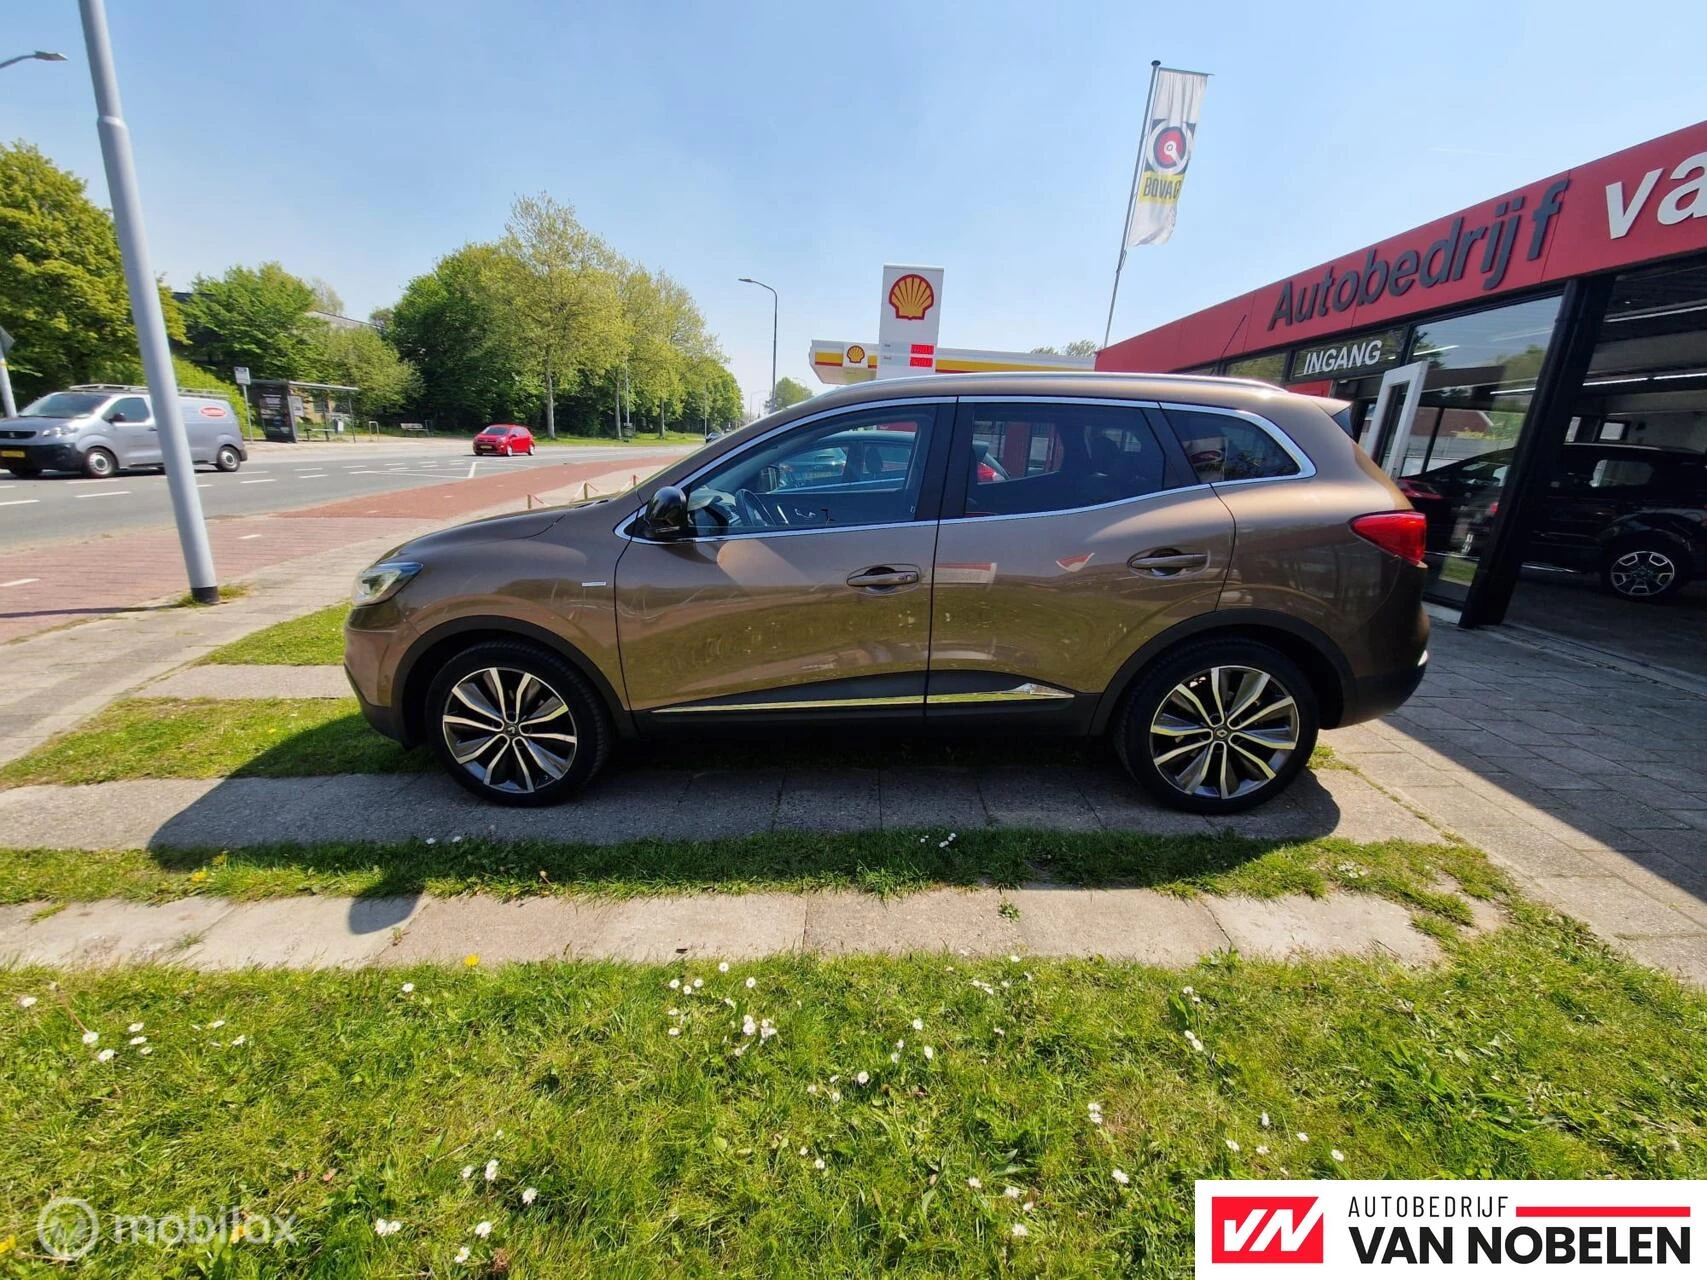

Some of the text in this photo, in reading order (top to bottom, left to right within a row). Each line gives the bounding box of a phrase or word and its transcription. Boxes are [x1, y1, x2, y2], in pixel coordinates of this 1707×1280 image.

[1143, 177, 1182, 199] BOVAG
[1267, 178, 1570, 331] Autobedrijf
[1303, 340, 1382, 375] INGANG
